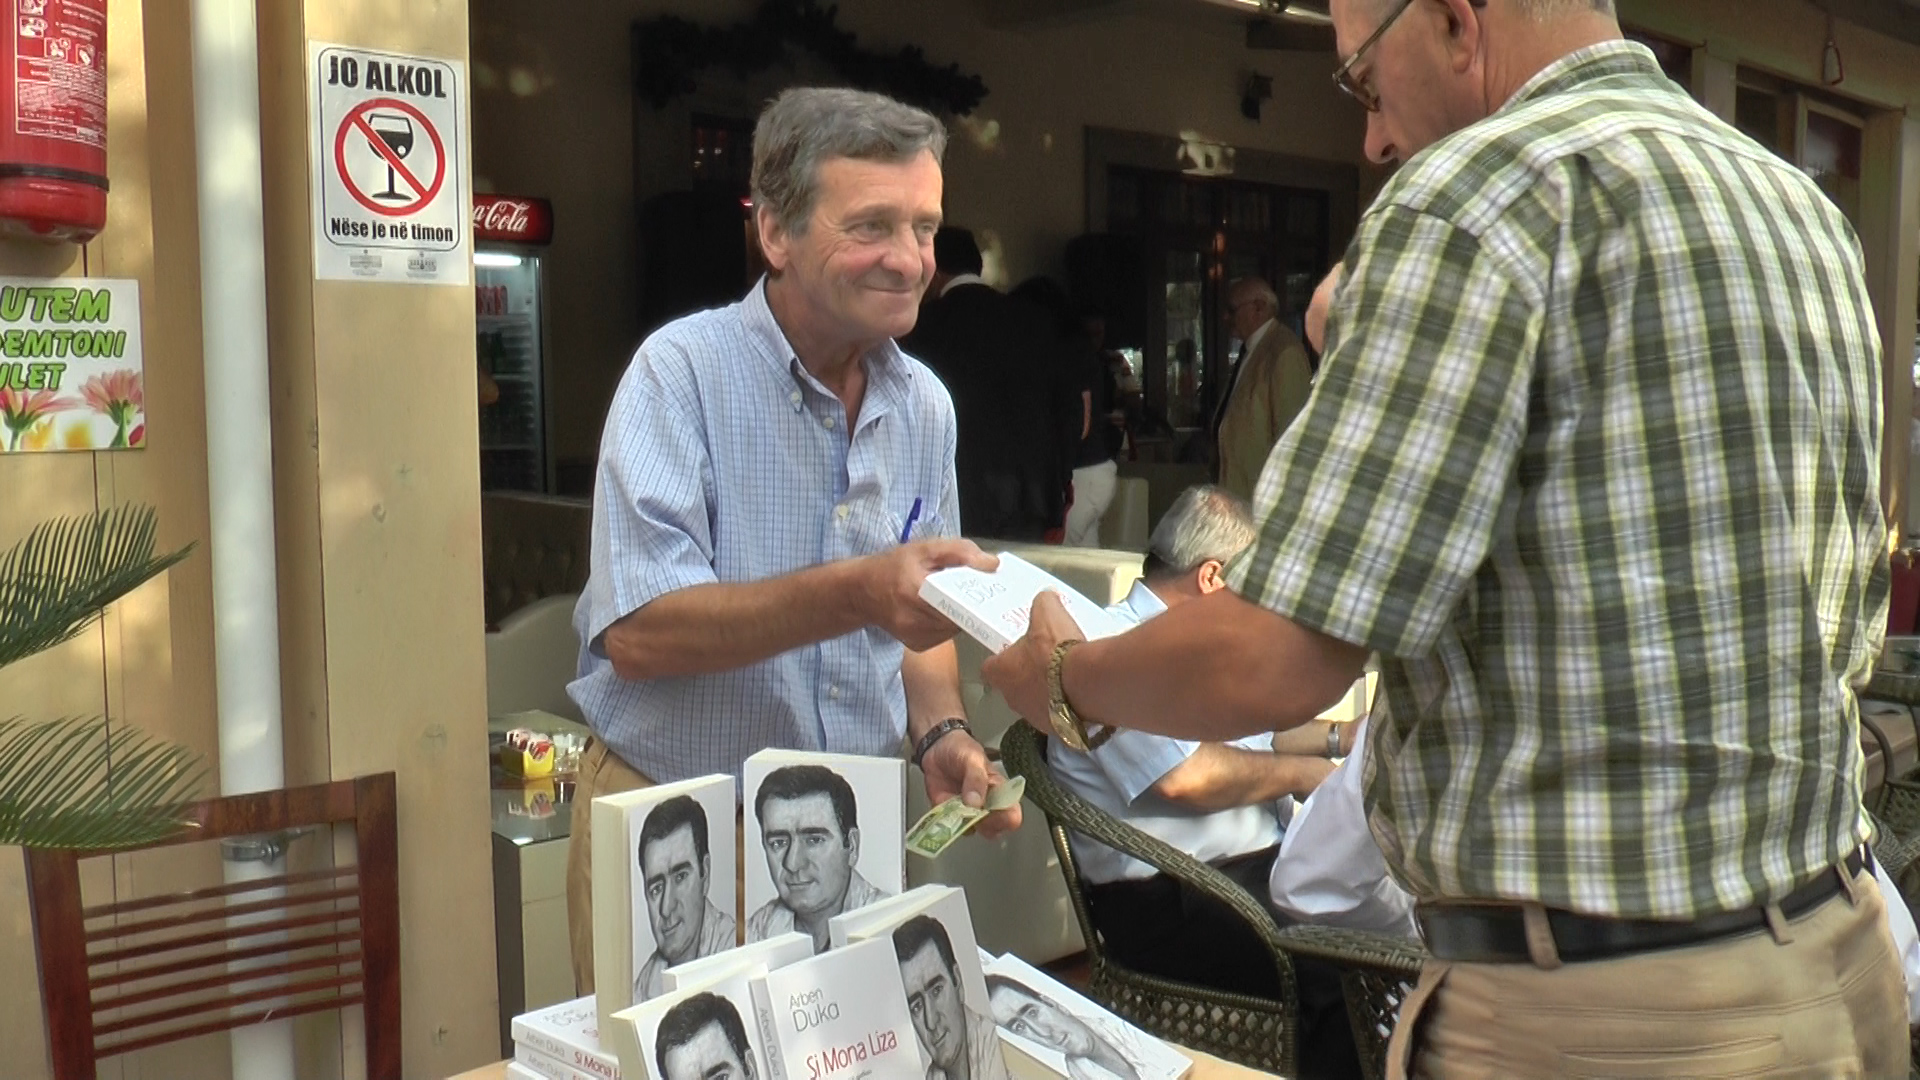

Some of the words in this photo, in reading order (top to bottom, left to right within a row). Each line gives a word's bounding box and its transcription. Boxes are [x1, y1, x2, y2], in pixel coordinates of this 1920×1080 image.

[328, 55, 358, 88] JO
[366, 60, 446, 98] ALKOL
[331, 217, 368, 238] Nëse
[372, 220, 386, 240] je
[390, 222, 408, 240] në
[411, 223, 453, 242] timon
[0, 329, 127, 358] EMTONI
[789, 987, 824, 1010] Arben
[792, 1002, 840, 1033] Duka
[806, 1053, 822, 1080] Si
[822, 1041, 868, 1075] Mona
[868, 1030, 898, 1056] Liza
